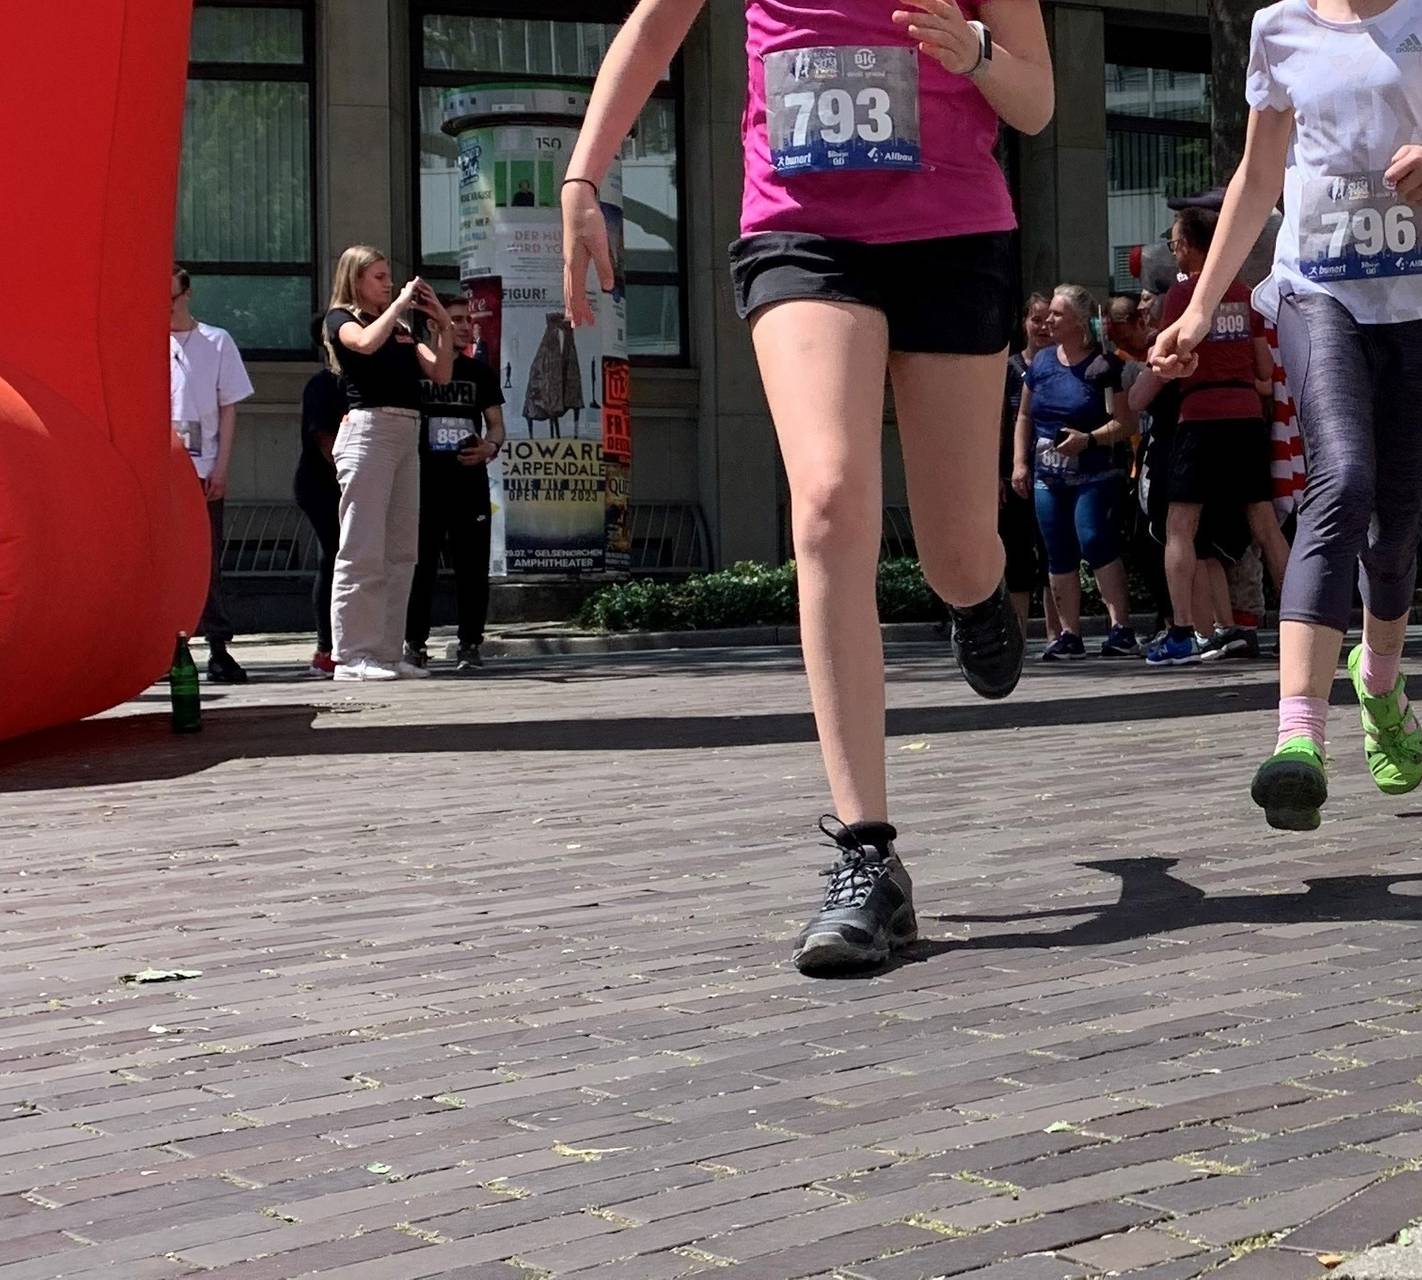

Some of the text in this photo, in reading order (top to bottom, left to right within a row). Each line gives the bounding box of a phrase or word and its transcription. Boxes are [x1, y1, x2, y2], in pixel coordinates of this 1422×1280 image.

[854, 53, 876, 65] BIG
[784, 87, 893, 147] 793
[1321, 204, 1416, 258] 796
[1217, 315, 1244, 333] 809
[508, 479, 534, 490] LIVE
[508, 490, 597, 502] OPEN AIR 2023
[513, 559, 594, 568] AMPHITHEATER
